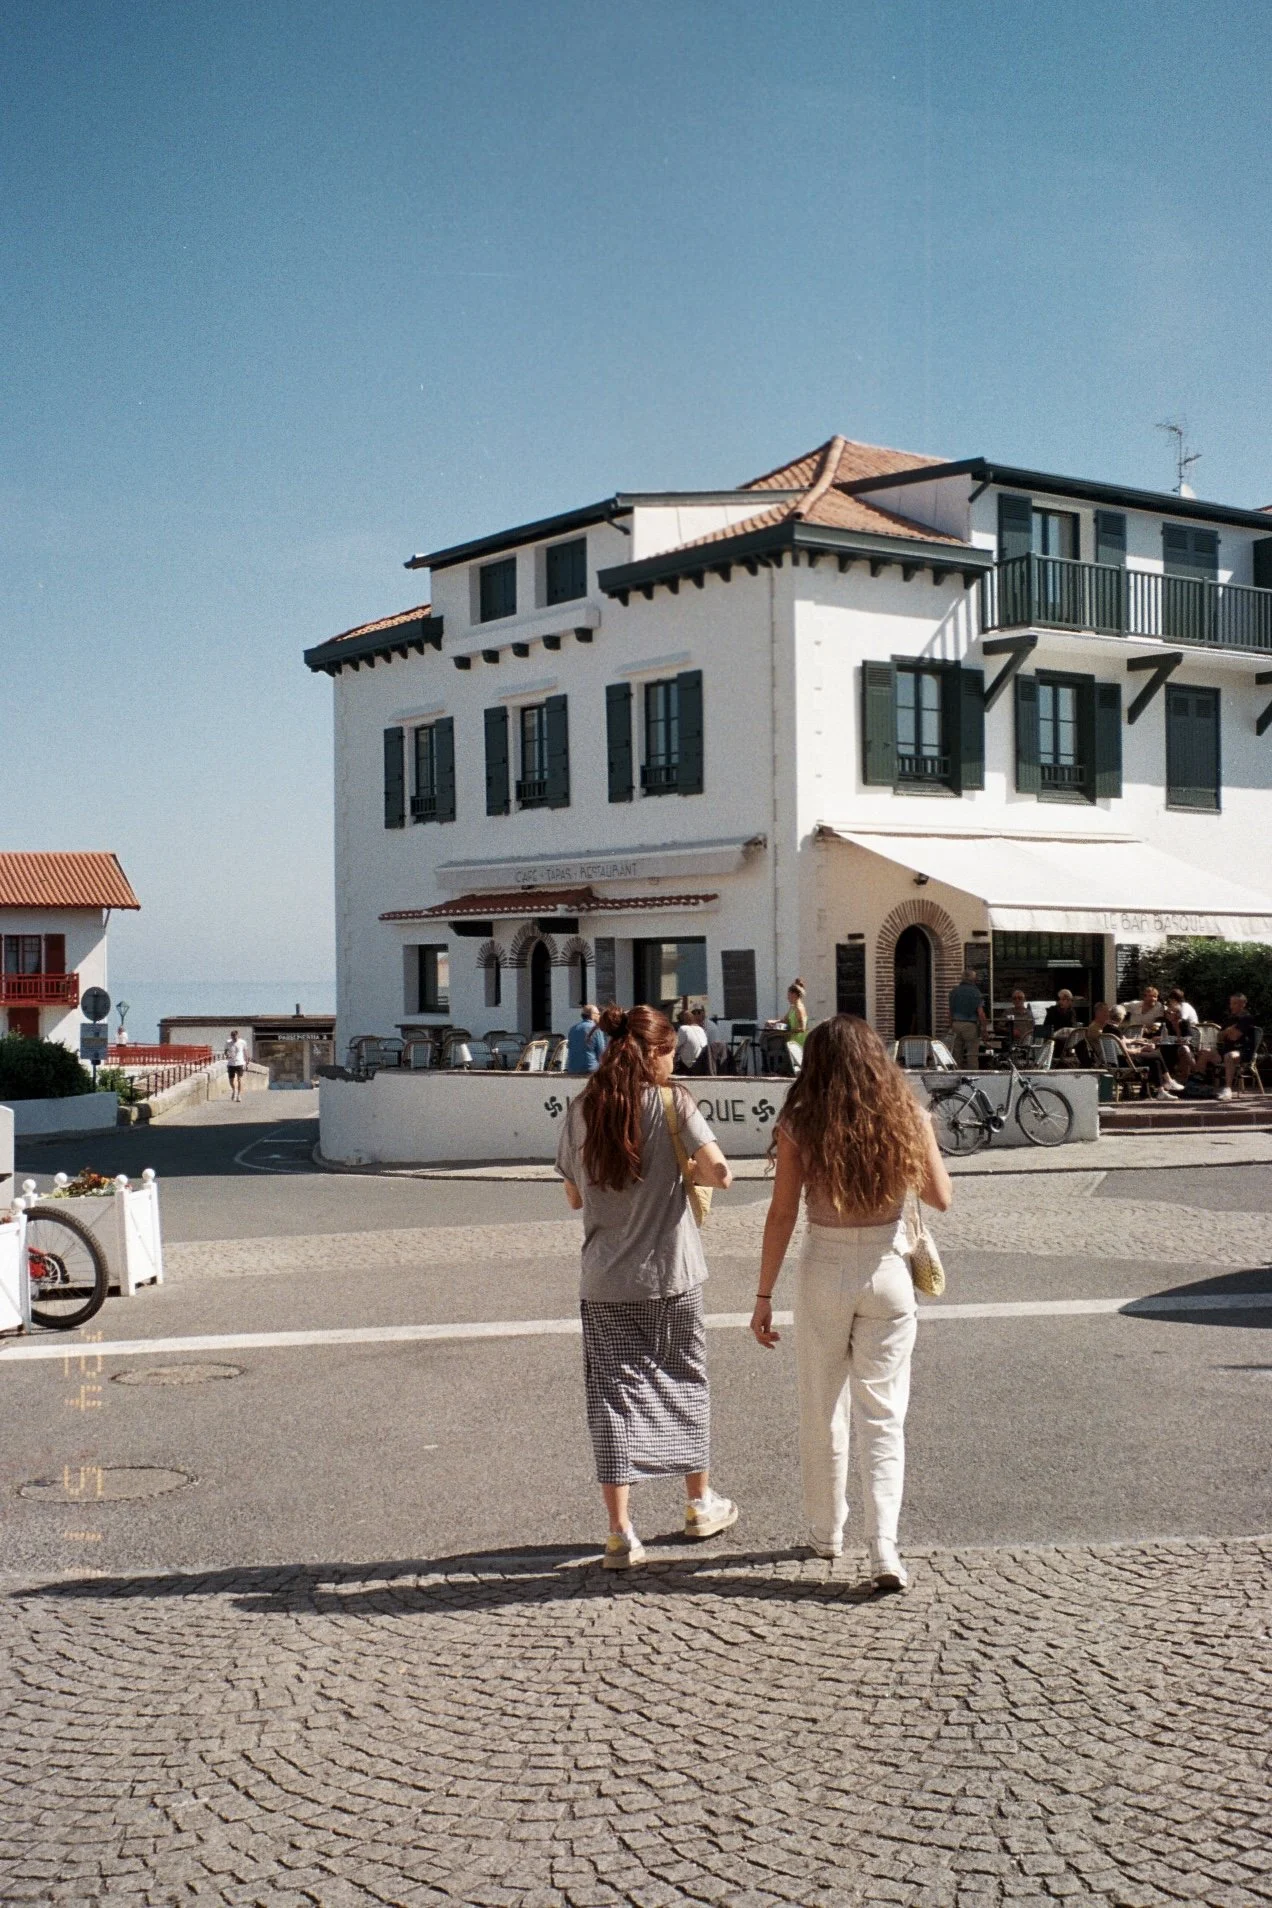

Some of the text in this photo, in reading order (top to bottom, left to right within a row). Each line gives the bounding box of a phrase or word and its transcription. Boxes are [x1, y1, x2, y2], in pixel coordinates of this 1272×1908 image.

[546, 867, 572, 881] TAPAS
[580, 862, 637, 879] RESTAURANT
[1103, 913, 1206, 932] LE BAR BASQUE
[697, 1099, 746, 1122] QUE
